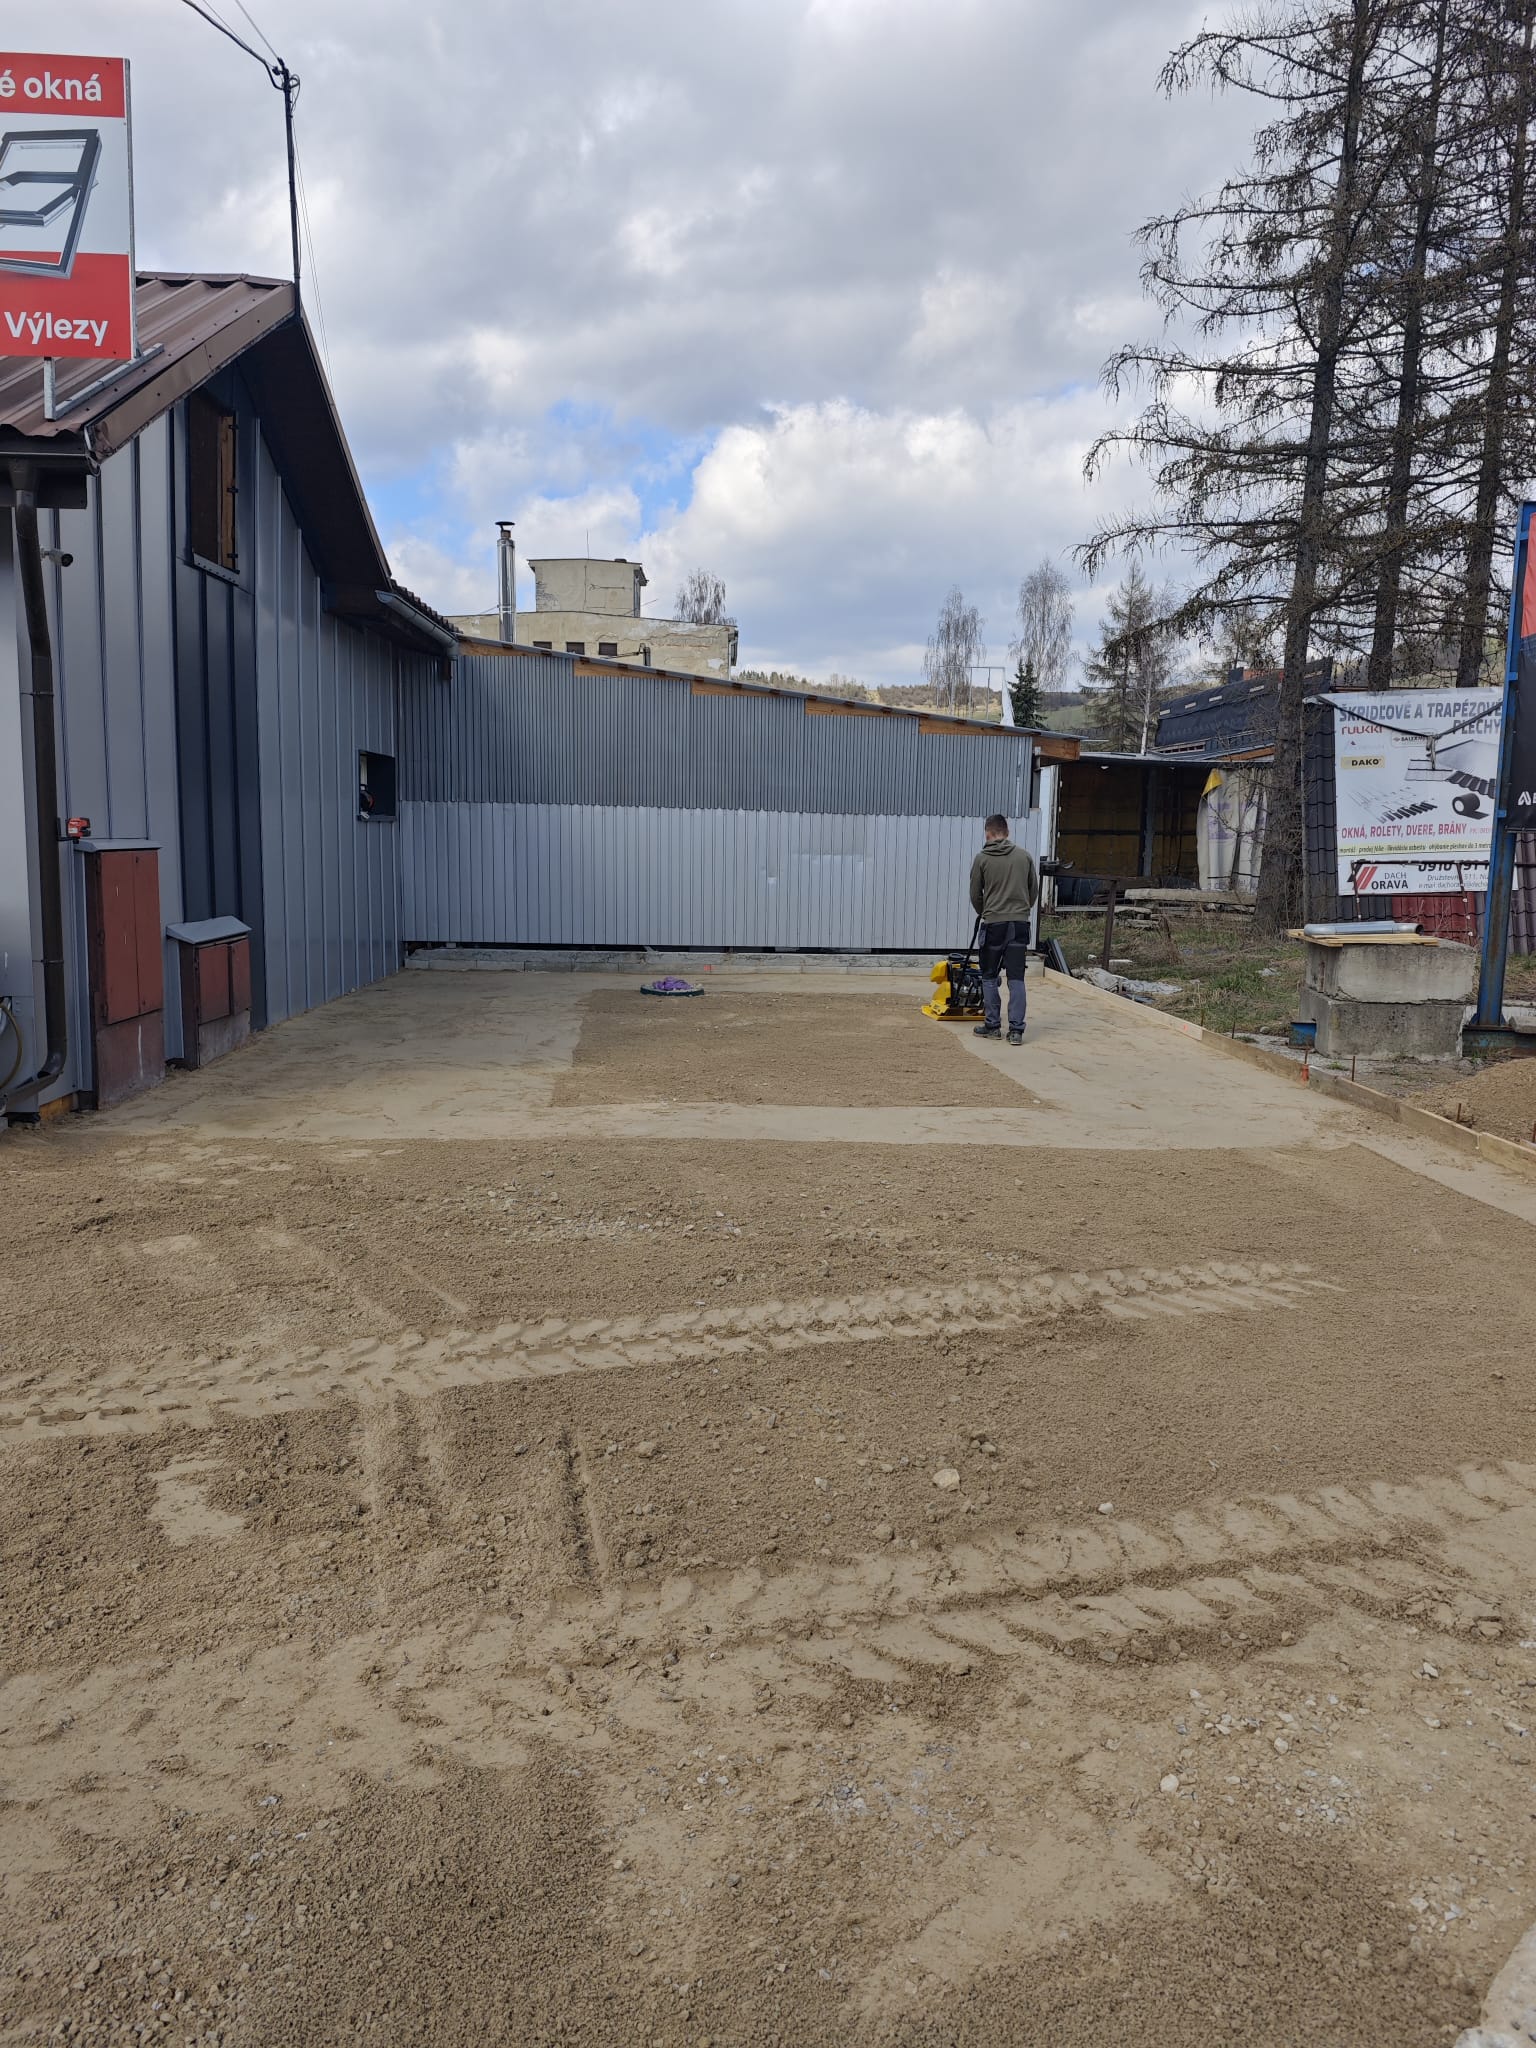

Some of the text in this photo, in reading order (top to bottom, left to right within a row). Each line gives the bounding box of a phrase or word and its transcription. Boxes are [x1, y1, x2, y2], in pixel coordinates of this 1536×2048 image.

[23, 71, 102, 102] okná
[4, 311, 109, 347] Výlezy
[1414, 703, 1423, 719] A
[1452, 720, 1501, 735] PLECHY
[1351, 758, 1380, 767] DAKO
[1341, 825, 1367, 839] OKNÁ,
[1370, 825, 1404, 839] ROLETY,
[1406, 823, 1436, 837] DVERE,
[1438, 821, 1467, 835] BRÁNY
[1384, 872, 1407, 880] DACH
[1371, 880, 1409, 890] ORAVA
